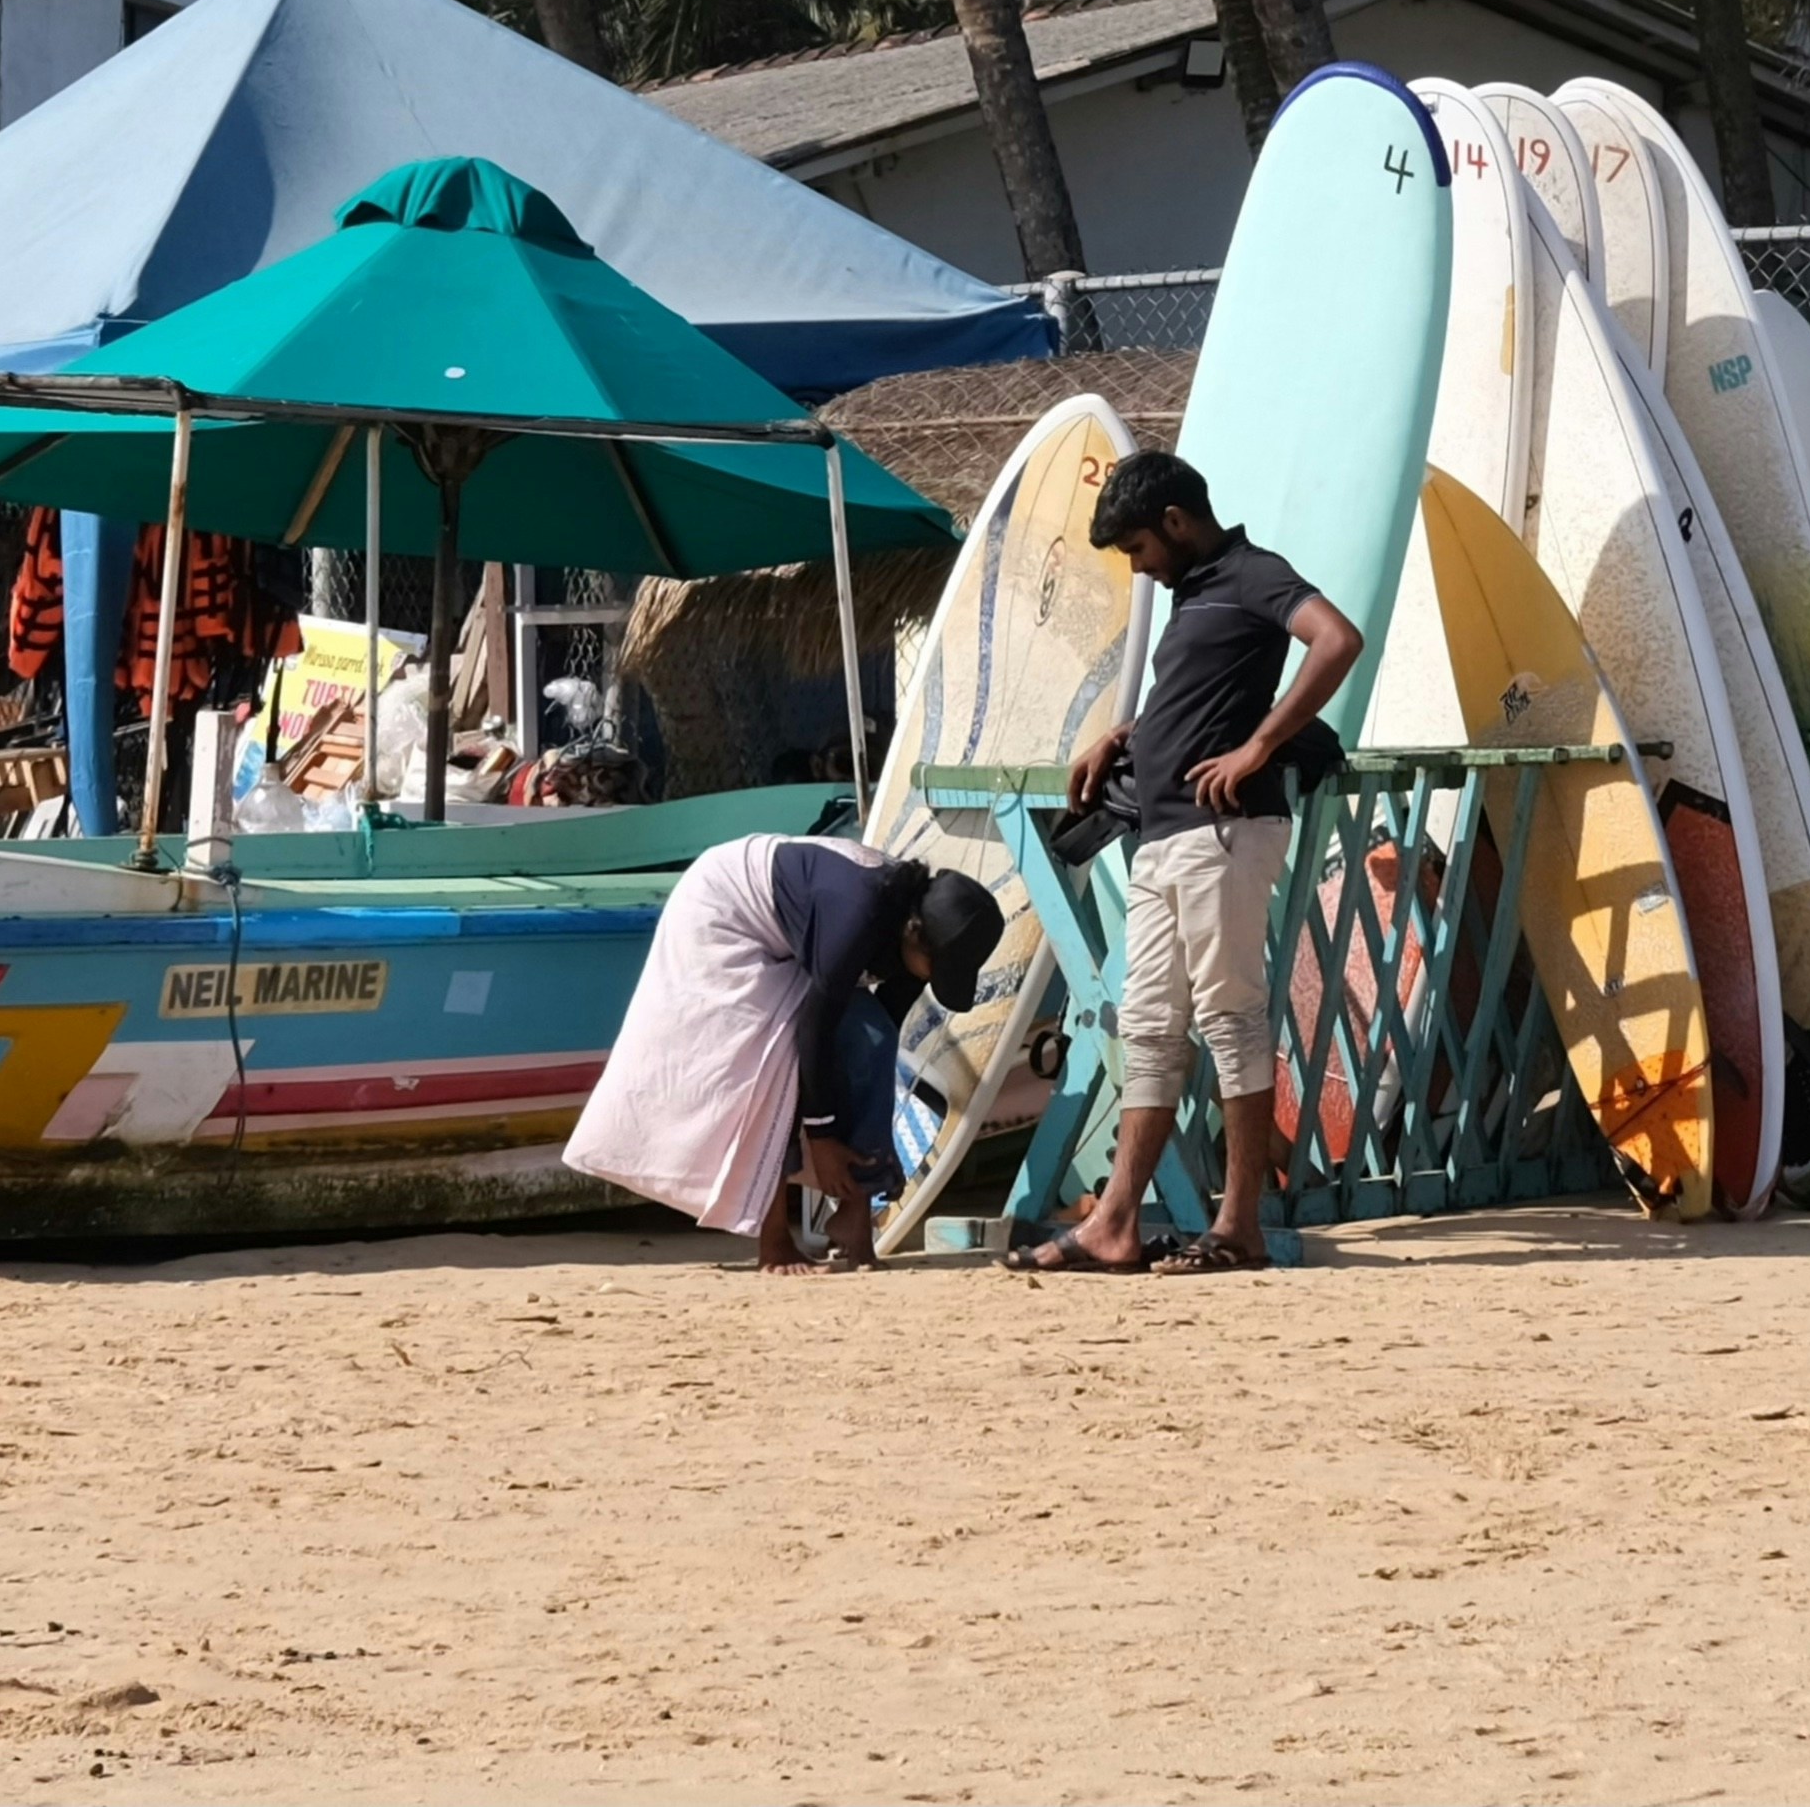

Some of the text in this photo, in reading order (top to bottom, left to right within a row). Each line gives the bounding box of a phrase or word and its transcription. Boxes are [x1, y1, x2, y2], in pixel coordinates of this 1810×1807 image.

[1383, 144, 1414, 195] 4
[1453, 139, 1489, 180] 14
[1517, 136, 1551, 176] 19
[1591, 144, 1631, 184] 17
[1707, 354, 1753, 395] NSP
[168, 962, 381, 1009] NEIL MARINE
